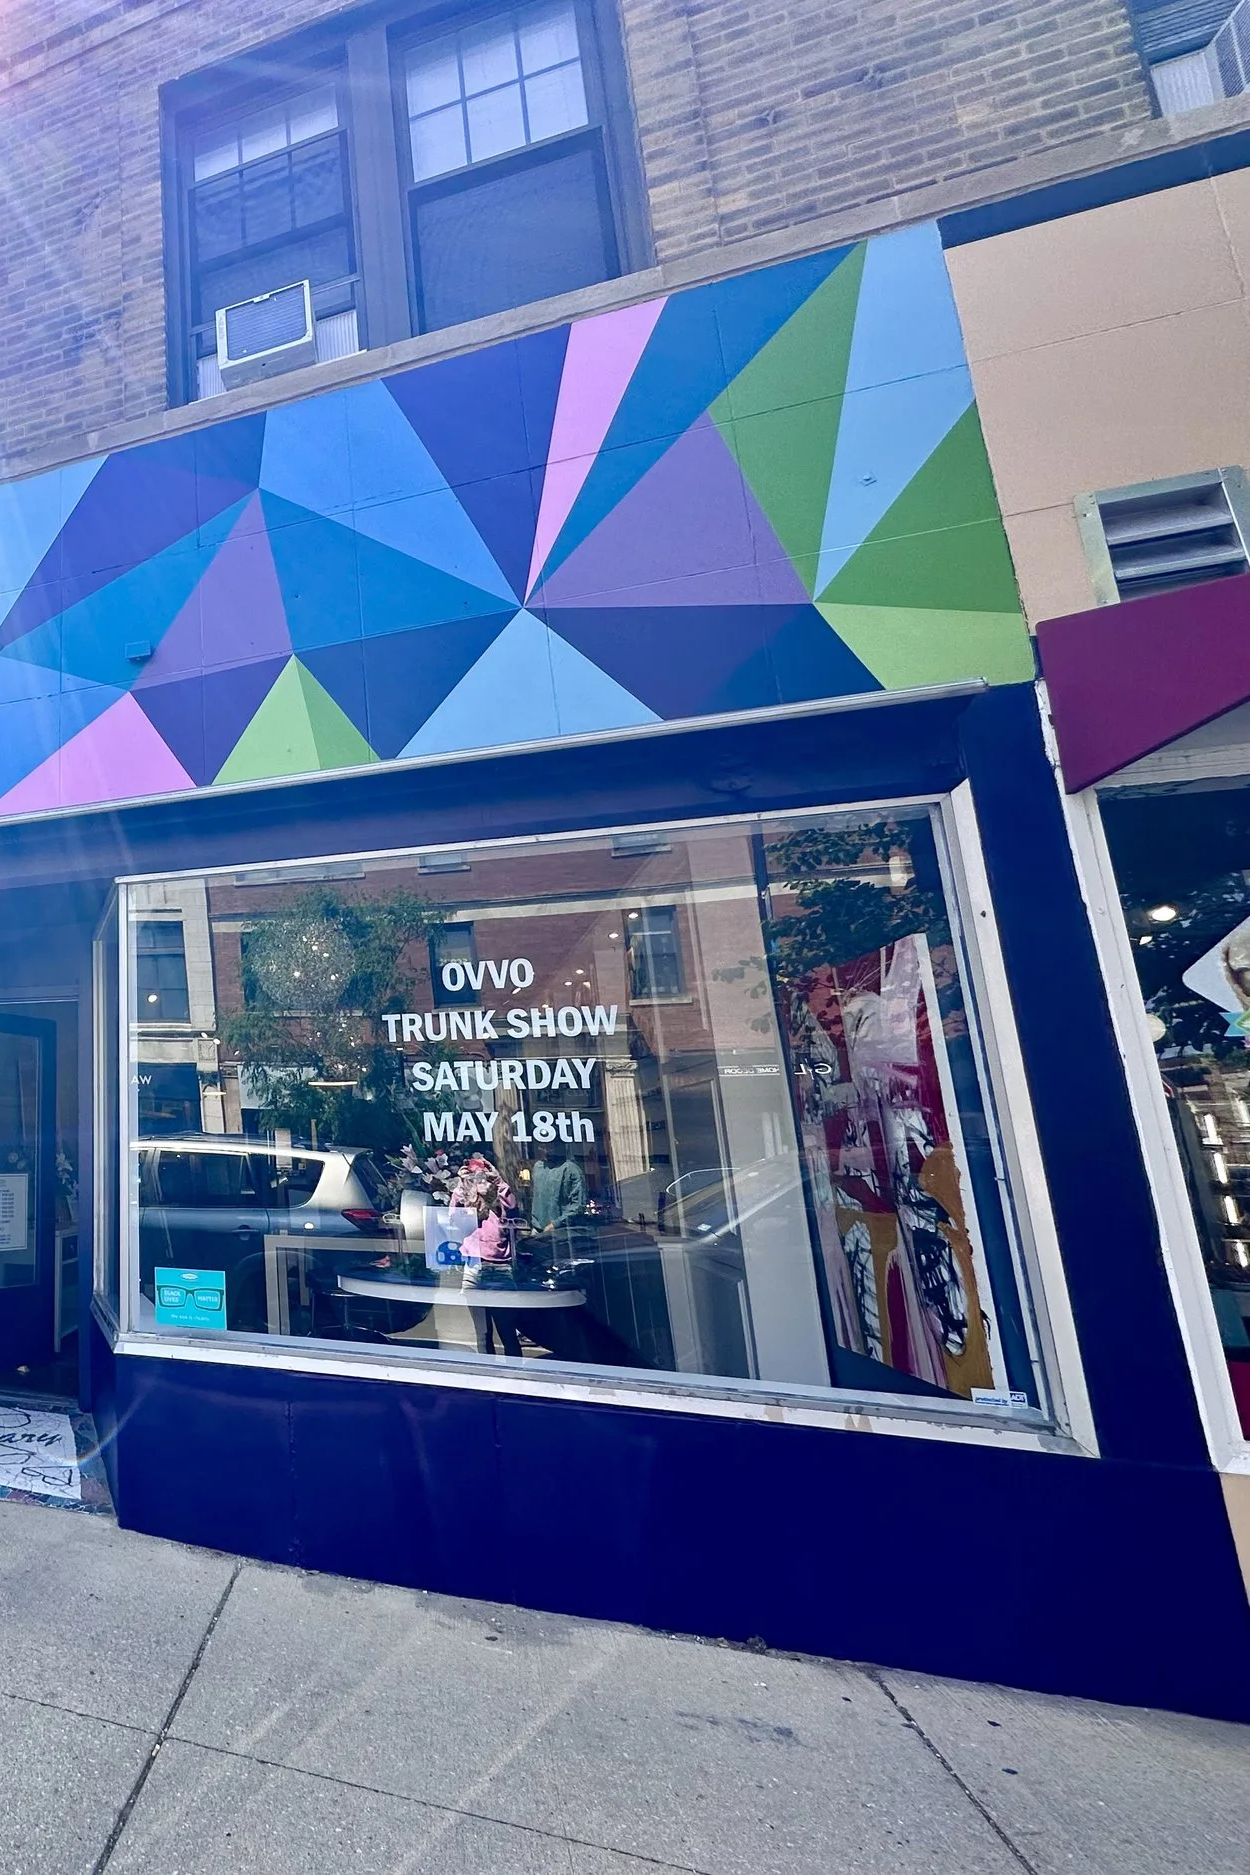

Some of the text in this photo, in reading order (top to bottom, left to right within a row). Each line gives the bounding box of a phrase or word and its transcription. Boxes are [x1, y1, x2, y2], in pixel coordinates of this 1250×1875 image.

[442, 957, 534, 992] OVVO
[381, 1004, 618, 1043] TRUNK SHOW
[411, 1057, 597, 1092] SATURDAY
[423, 1110, 595, 1143] MAY 18th
